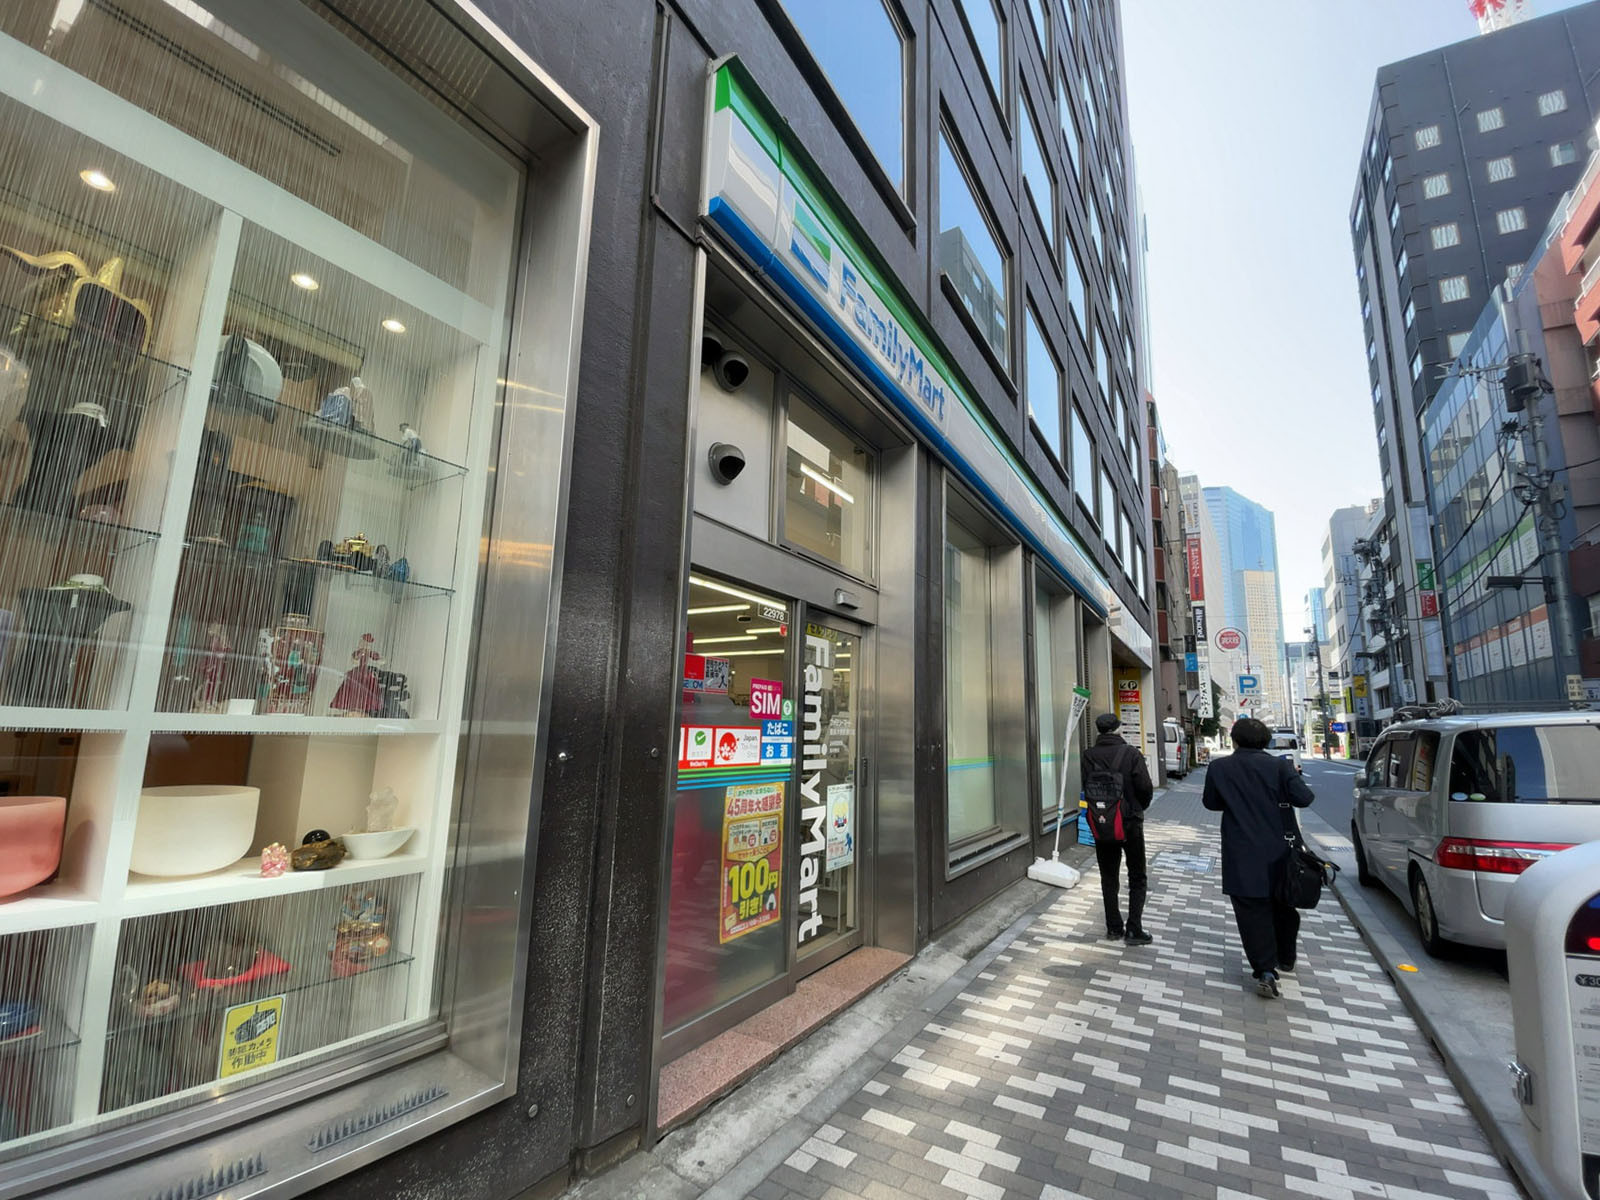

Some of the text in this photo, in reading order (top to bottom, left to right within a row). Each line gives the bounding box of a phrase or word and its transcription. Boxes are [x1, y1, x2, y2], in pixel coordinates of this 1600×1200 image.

[840, 262, 945, 420] FamilyMart
[763, 606, 785, 621] 22978
[1239, 675, 1258, 694] P
[751, 691, 781, 715] SIM
[766, 722, 789, 735] たばこ
[799, 634, 829, 942] FamilyMart
[729, 858, 778, 904] 100円
[231, 1050, 267, 1069] 作動中
